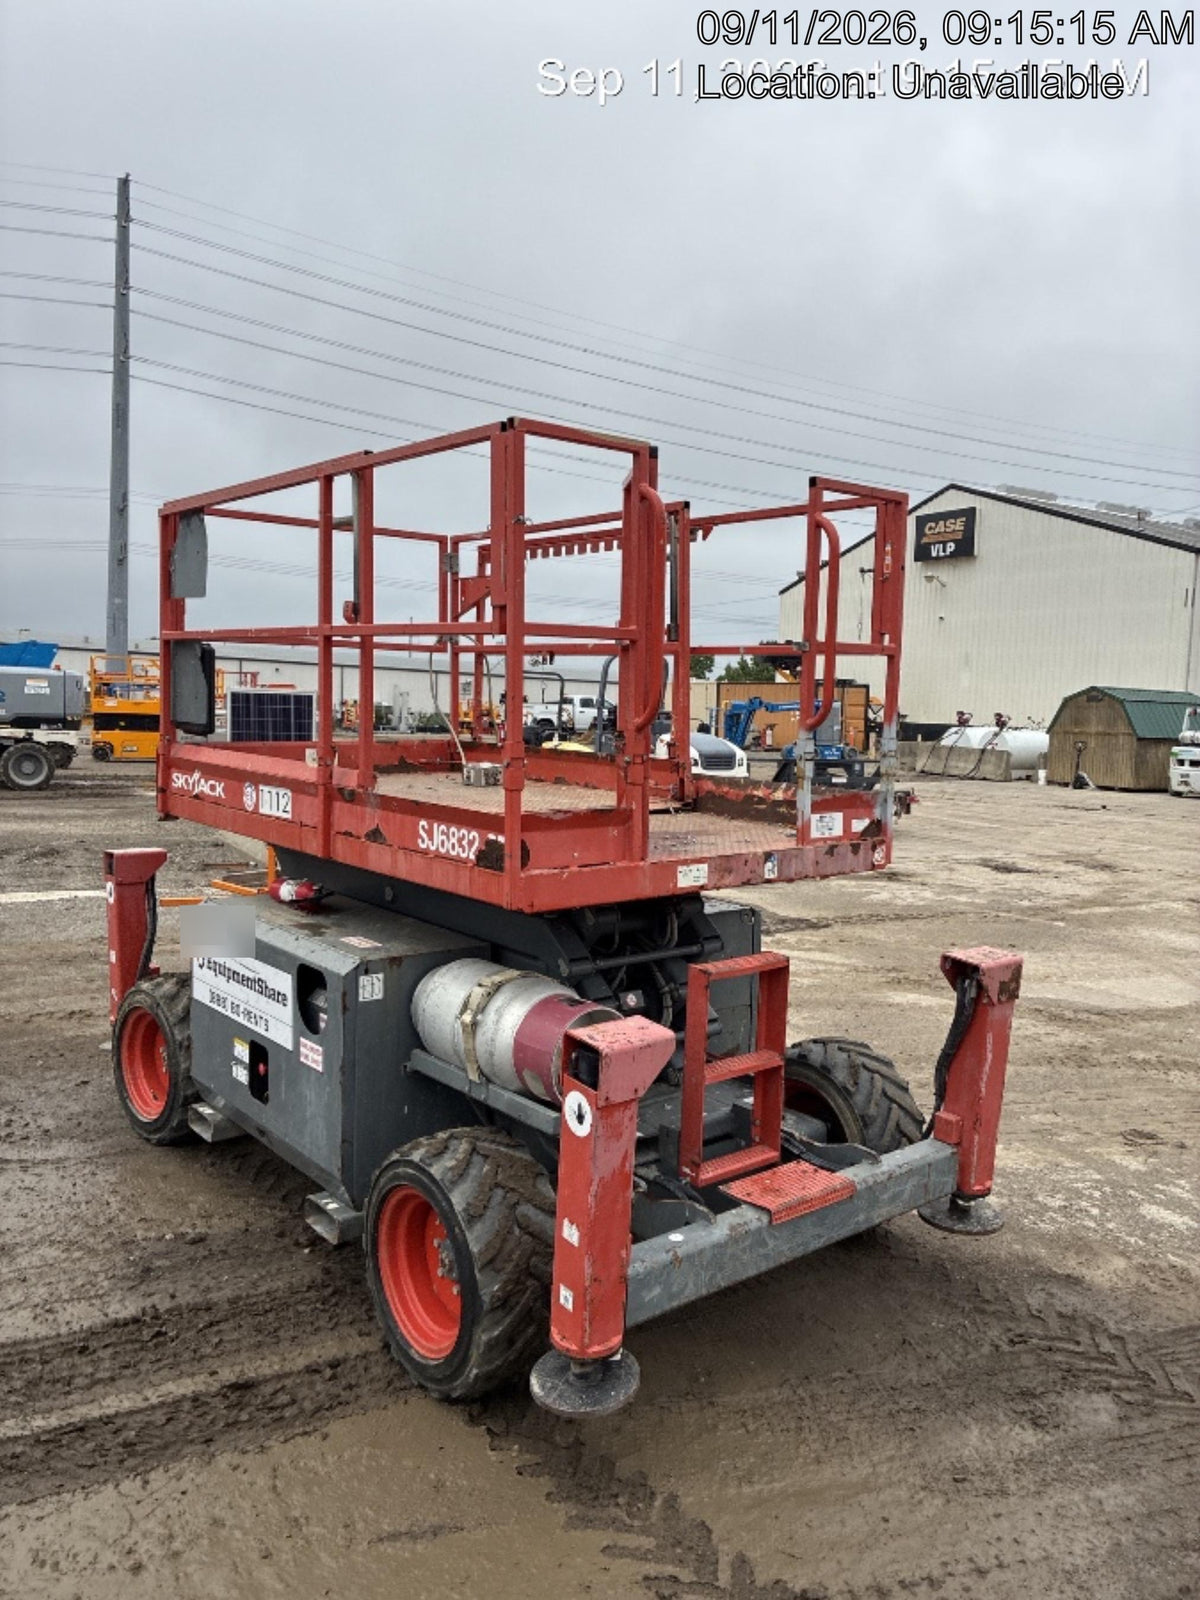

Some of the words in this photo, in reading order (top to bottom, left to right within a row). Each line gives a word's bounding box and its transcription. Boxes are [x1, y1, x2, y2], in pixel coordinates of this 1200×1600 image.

[924, 517, 966, 534] CASE
[931, 542, 955, 557] VLP
[171, 769, 226, 799] SKYJACK
[417, 819, 480, 860] SJ6832
[206, 957, 289, 1008] EquipmentShare
